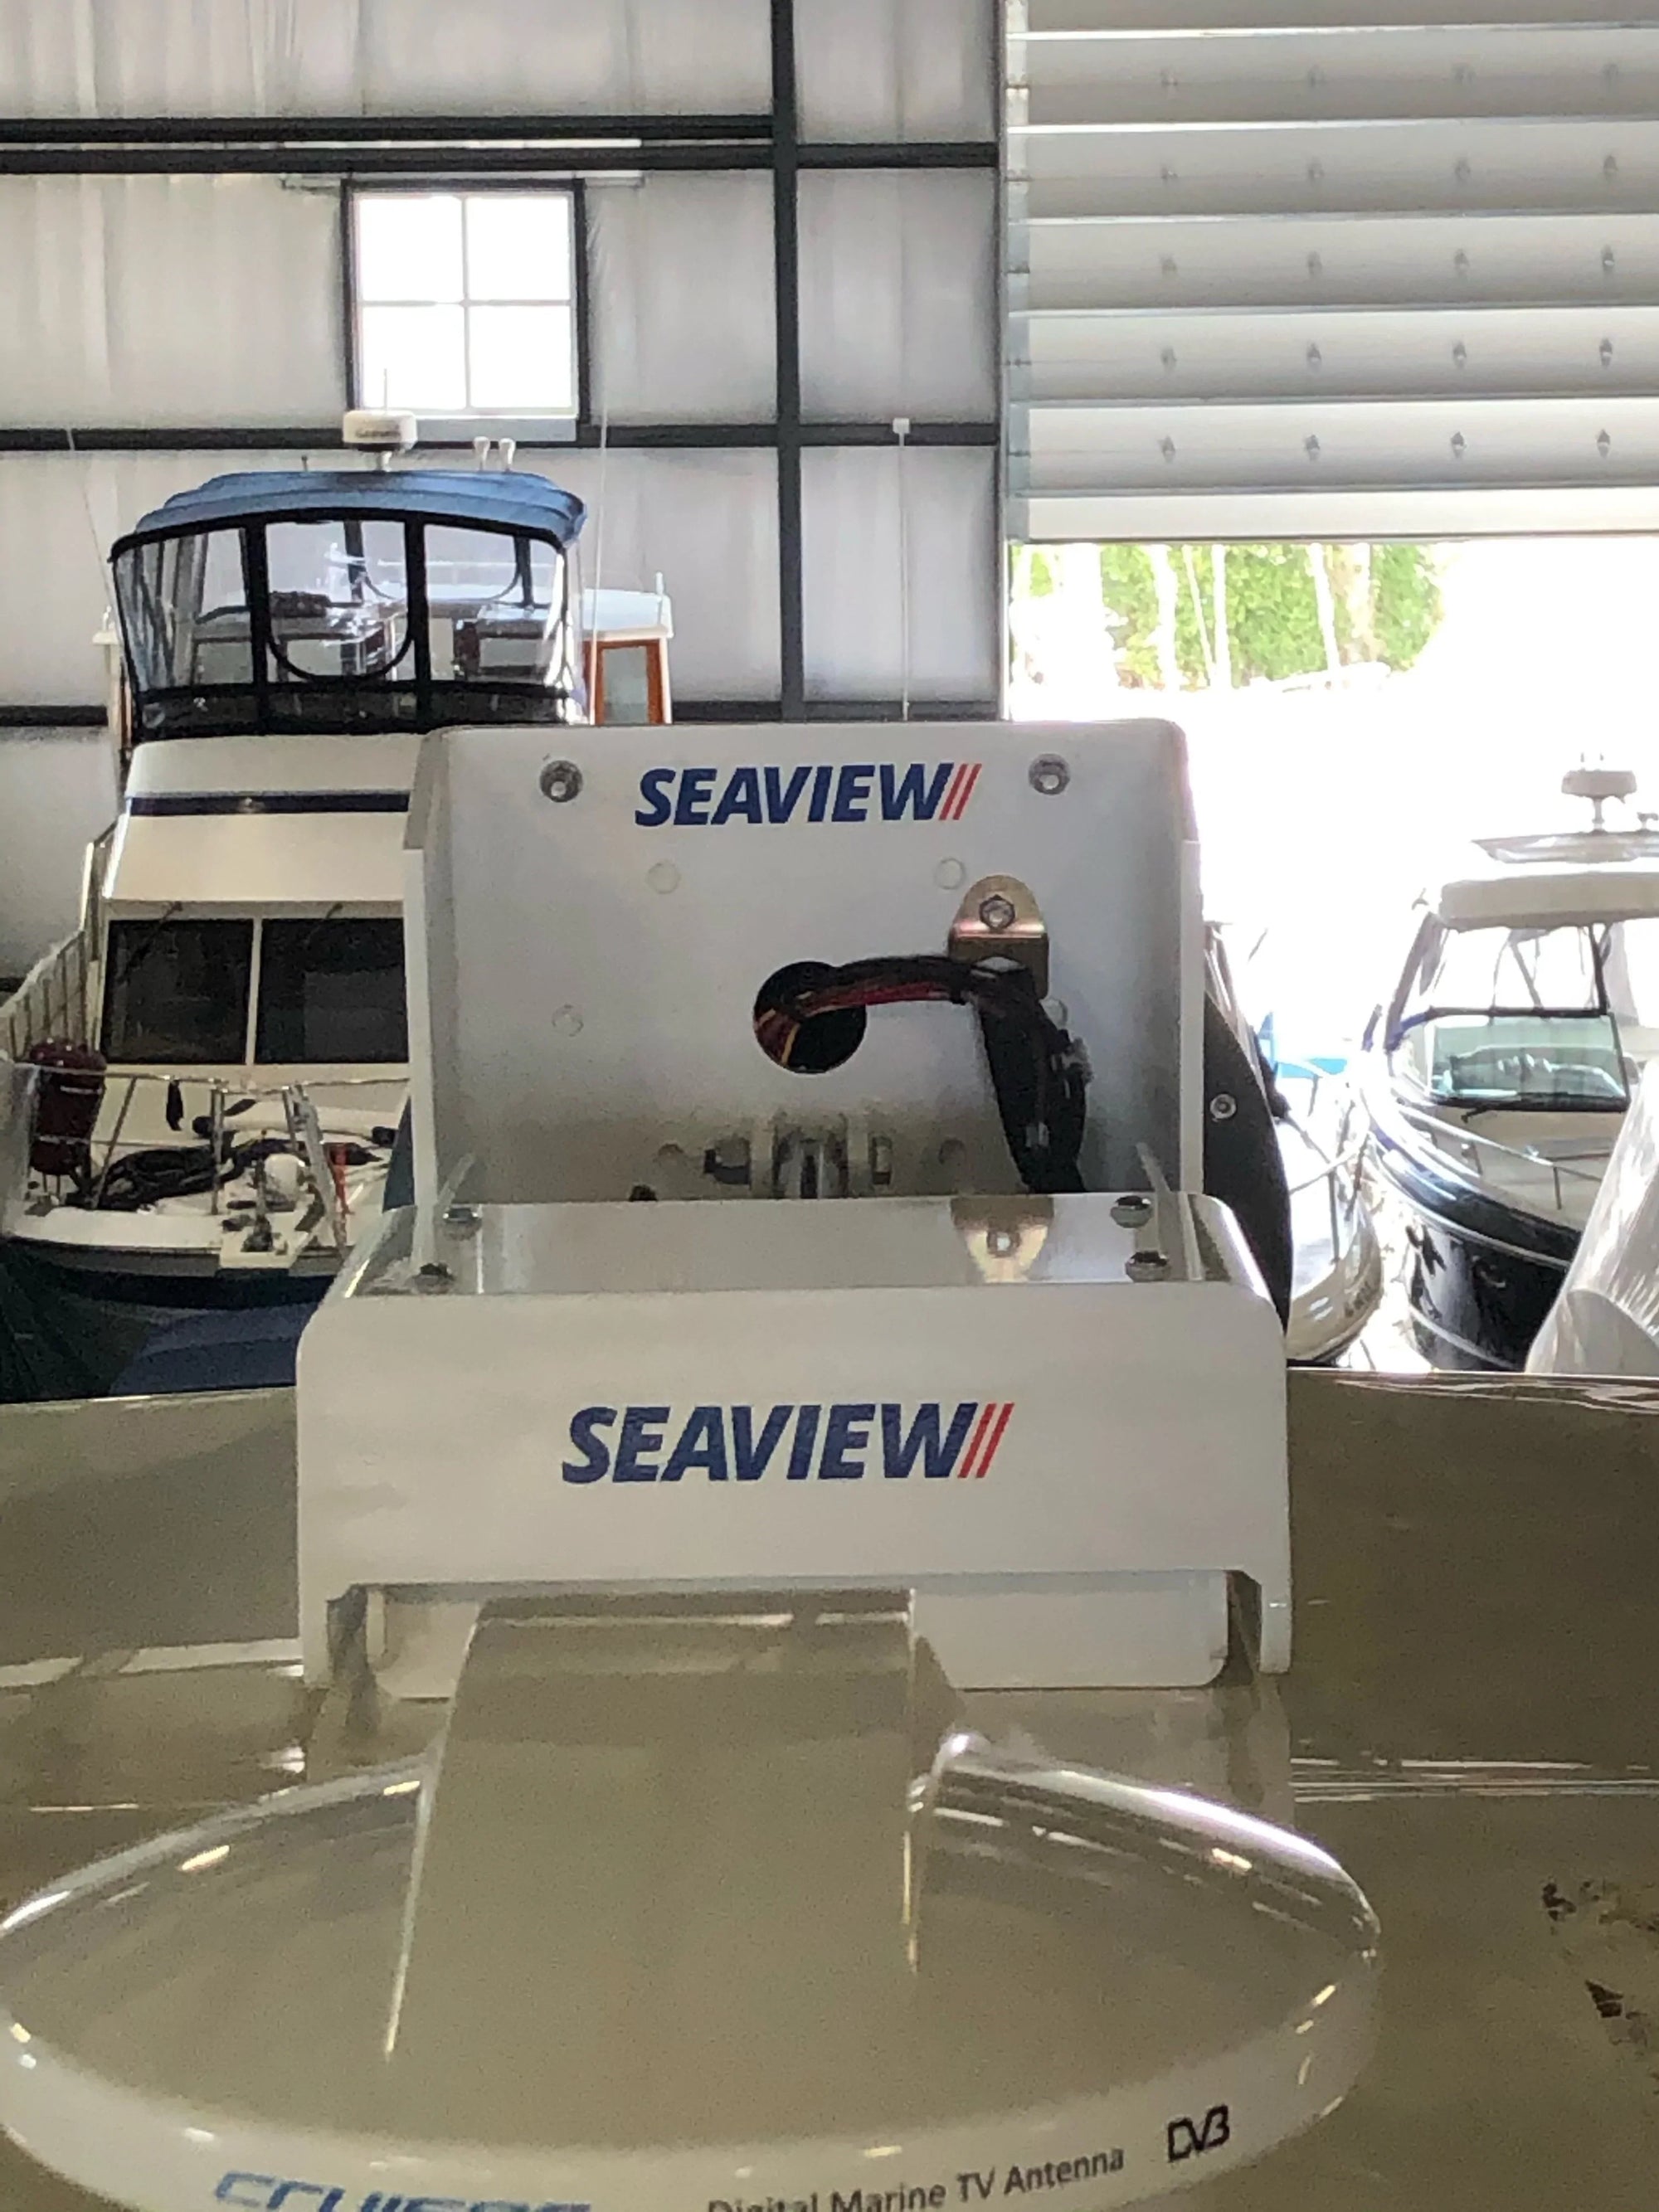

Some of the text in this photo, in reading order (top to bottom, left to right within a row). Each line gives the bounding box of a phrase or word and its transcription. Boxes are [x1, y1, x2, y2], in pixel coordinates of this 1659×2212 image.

[635, 763, 955, 827] SEAVIEW
[562, 1403, 978, 1483] SEAVIEW
[1167, 2103, 1230, 2163] DVB
[831, 2182, 946, 2212] Marine
[956, 2167, 995, 2202] TV
[1004, 2148, 1124, 2195] Antenna
